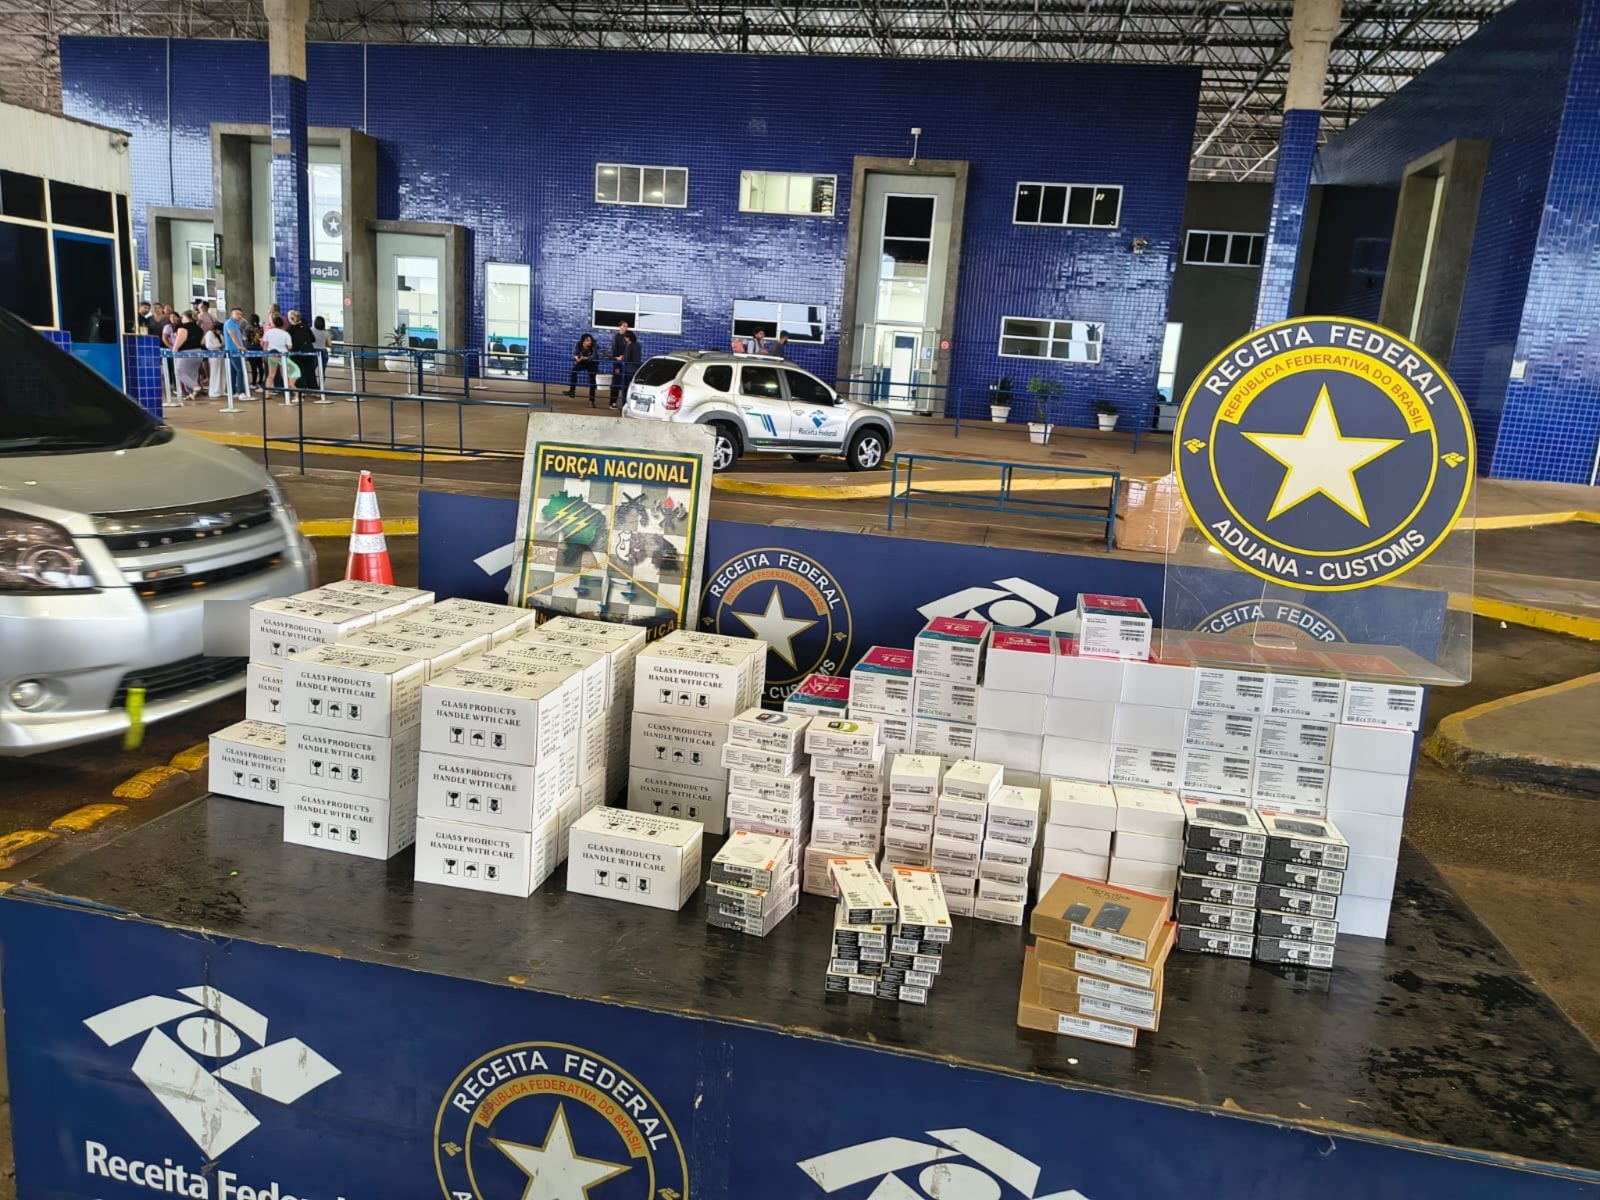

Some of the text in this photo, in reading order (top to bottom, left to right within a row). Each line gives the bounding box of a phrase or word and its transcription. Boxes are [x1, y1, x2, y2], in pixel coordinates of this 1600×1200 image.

[1204, 325, 1443, 405] RECEITA FEDERAL
[1224, 354, 1424, 428] REPÚBLICA FEDERATIVA DO BRASIL
[799, 428, 817, 436] Receita
[544, 454, 688, 483] FORÇA NACIONAL
[1212, 519, 1298, 577] ADUANA
[1319, 530, 1425, 580] CUSTOMS
[710, 554, 840, 610] RECEITA FEDERAL
[758, 571, 798, 583] FEDERATIVA
[799, 580, 808, 589] DO
[808, 588, 823, 612] BRASIL
[264, 619, 322, 634] GLASS PRODUCTS
[1277, 607, 1335, 642] FEDER
[260, 627, 326, 644] HANDLE WITH CARE
[301, 672, 371, 688] GLASS PRODUCTS
[649, 675, 679, 684] HANDLE
[654, 666, 719, 679] GLASS PRODUCTS
[296, 681, 376, 698] HANDLE WITH CARE
[442, 700, 515, 716] GLASS PRODUCTS
[437, 710, 521, 726] HANDLE WITH CARE
[644, 731, 673, 740] HANDLE
[648, 723, 712, 737] GLASS PRODUCTS
[303, 735, 371, 751] GLASS PRODUCTS
[226, 748, 247, 757] GLASS
[298, 743, 376, 761] HANDLE WITH CARE
[222, 755, 249, 766] HANDLE
[250, 760, 270, 770] WITH
[439, 765, 512, 781] GLASS PRODUCTS
[433, 774, 517, 791] HANDLE WITH CARE
[645, 778, 709, 792] GLASS PRODUCTS
[640, 786, 669, 795] HANDLE
[671, 790, 691, 798] WITH
[302, 795, 369, 813] GLASS PRODUCTS
[297, 805, 374, 823] HANDLE WITH CARE
[436, 832, 510, 848] GLASS PRODUCTS
[430, 841, 514, 859] HANDLE WITH CARE
[588, 843, 661, 861] GLASS PRODUCTS
[582, 852, 666, 872] HANDLE WITH CARE
[452, 1050, 668, 1151] RECEITA FEDERAL
[529, 1079, 596, 1103] FEDERATIVA
[598, 1099, 614, 1116] DO
[613, 1113, 640, 1153] BRASIL
[86, 1140, 209, 1200] Receita
